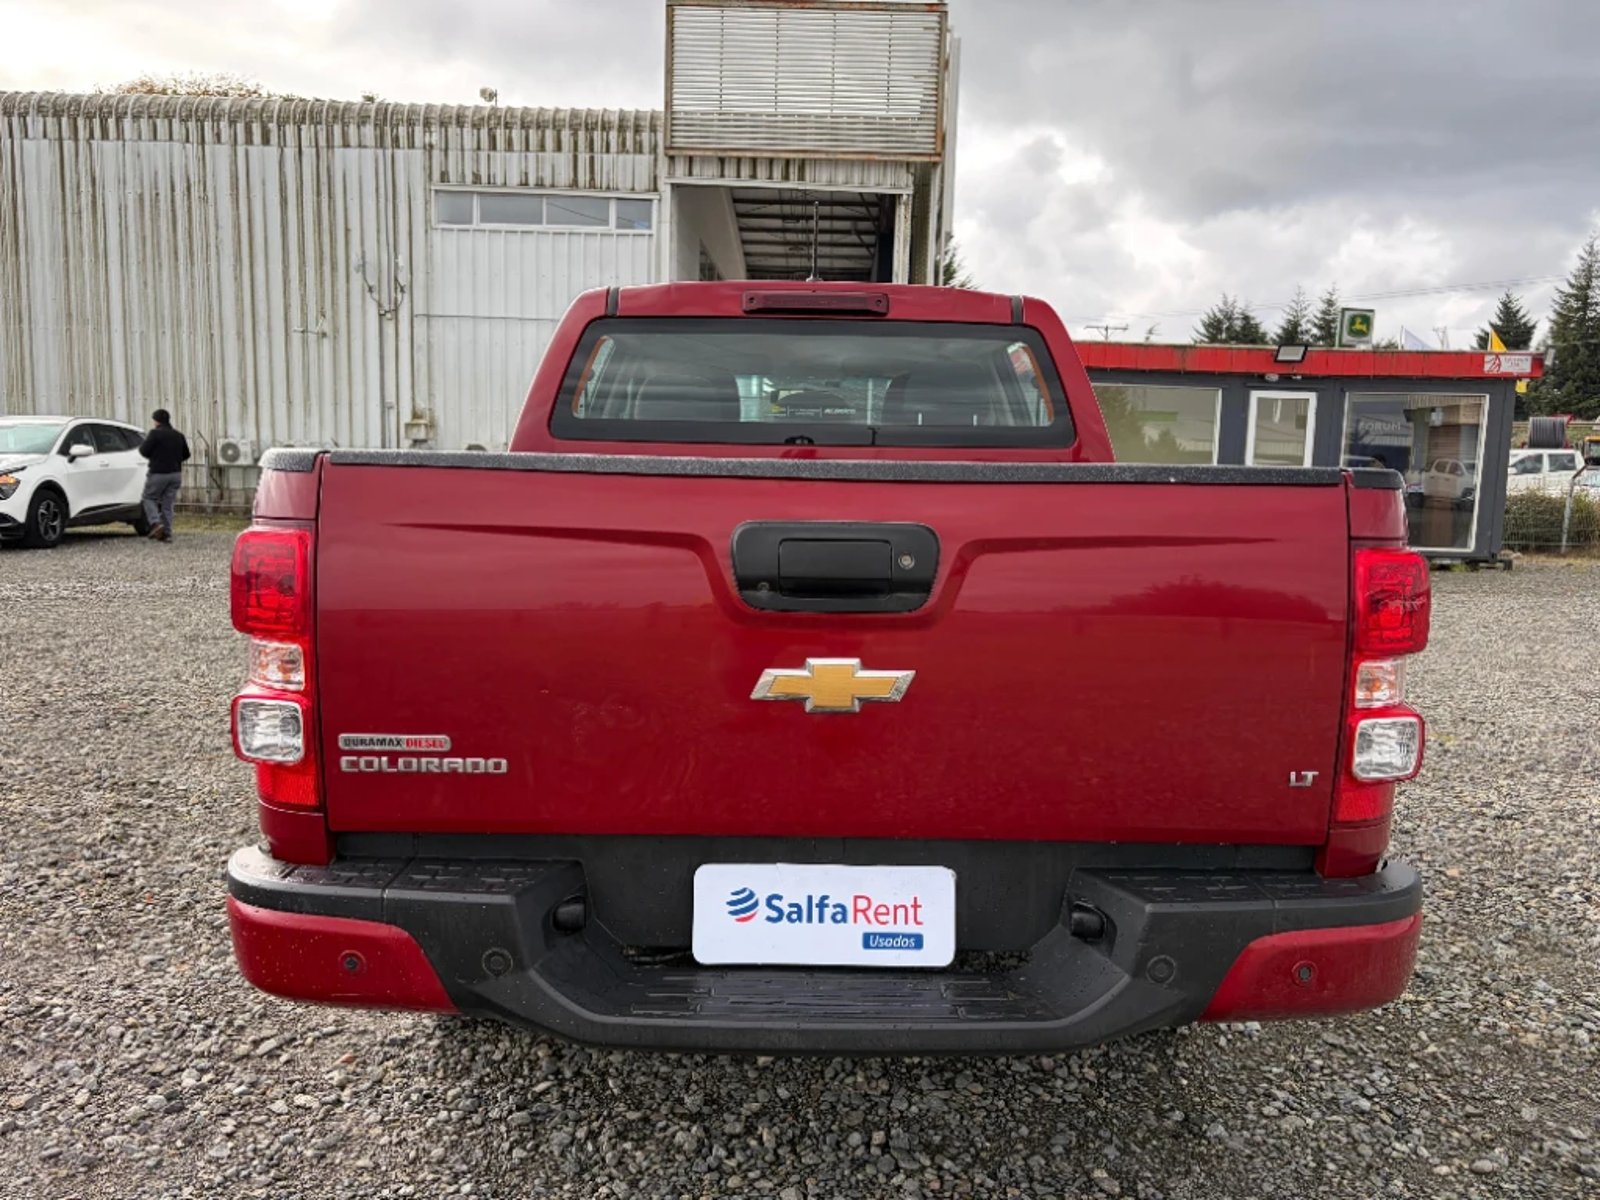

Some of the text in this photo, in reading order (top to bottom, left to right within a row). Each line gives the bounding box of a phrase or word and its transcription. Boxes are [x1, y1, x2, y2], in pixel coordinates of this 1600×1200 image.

[343, 737, 445, 748] DURAMAX DIESEL
[340, 756, 508, 774] COLORADO
[1289, 771, 1320, 787] LT
[764, 893, 924, 926] SalfaRent
[869, 935, 916, 948] Usados
